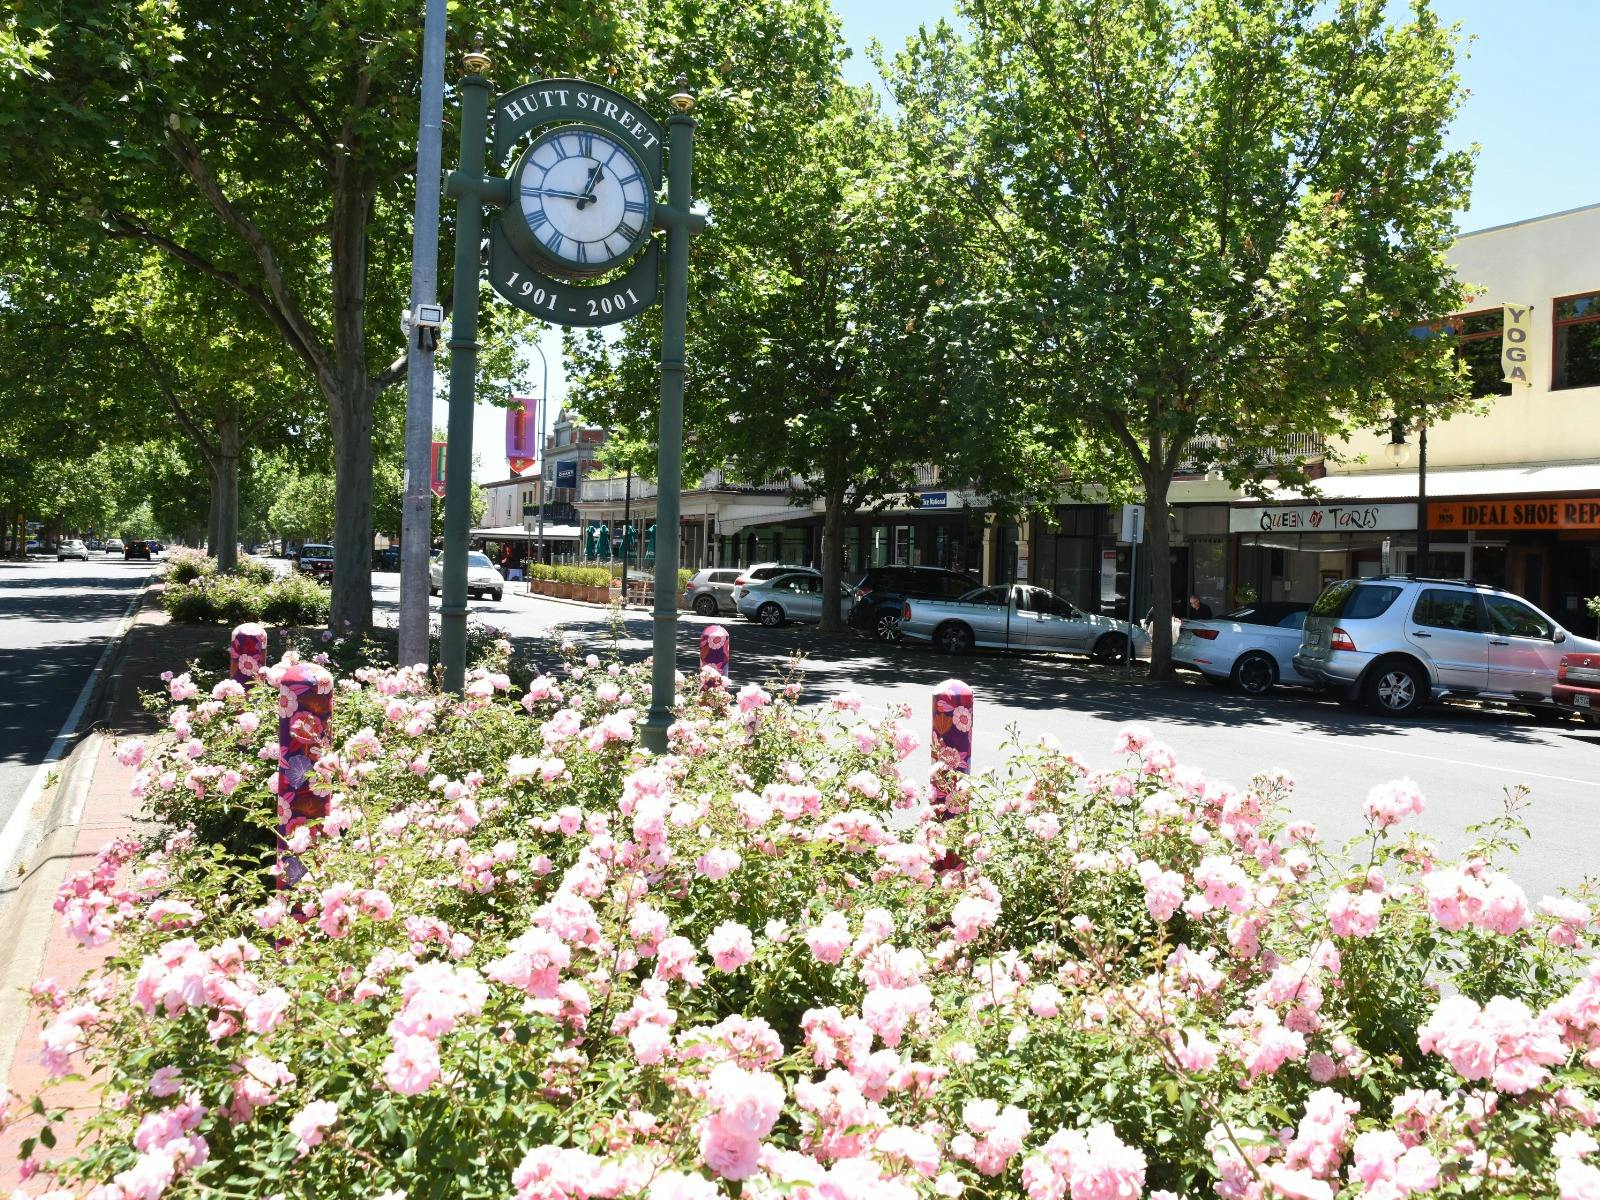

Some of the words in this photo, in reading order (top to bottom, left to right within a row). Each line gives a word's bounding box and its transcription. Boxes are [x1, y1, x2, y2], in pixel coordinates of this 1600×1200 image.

[503, 89, 570, 122] HUTT
[576, 92, 660, 151] STREET
[505, 271, 558, 311] 1901
[586, 288, 640, 317] 2001
[1505, 307, 1527, 382] YOGA
[1462, 504, 1509, 526] IDEAL
[1513, 503, 1559, 525] SHOE
[1564, 503, 1600, 524] REP
